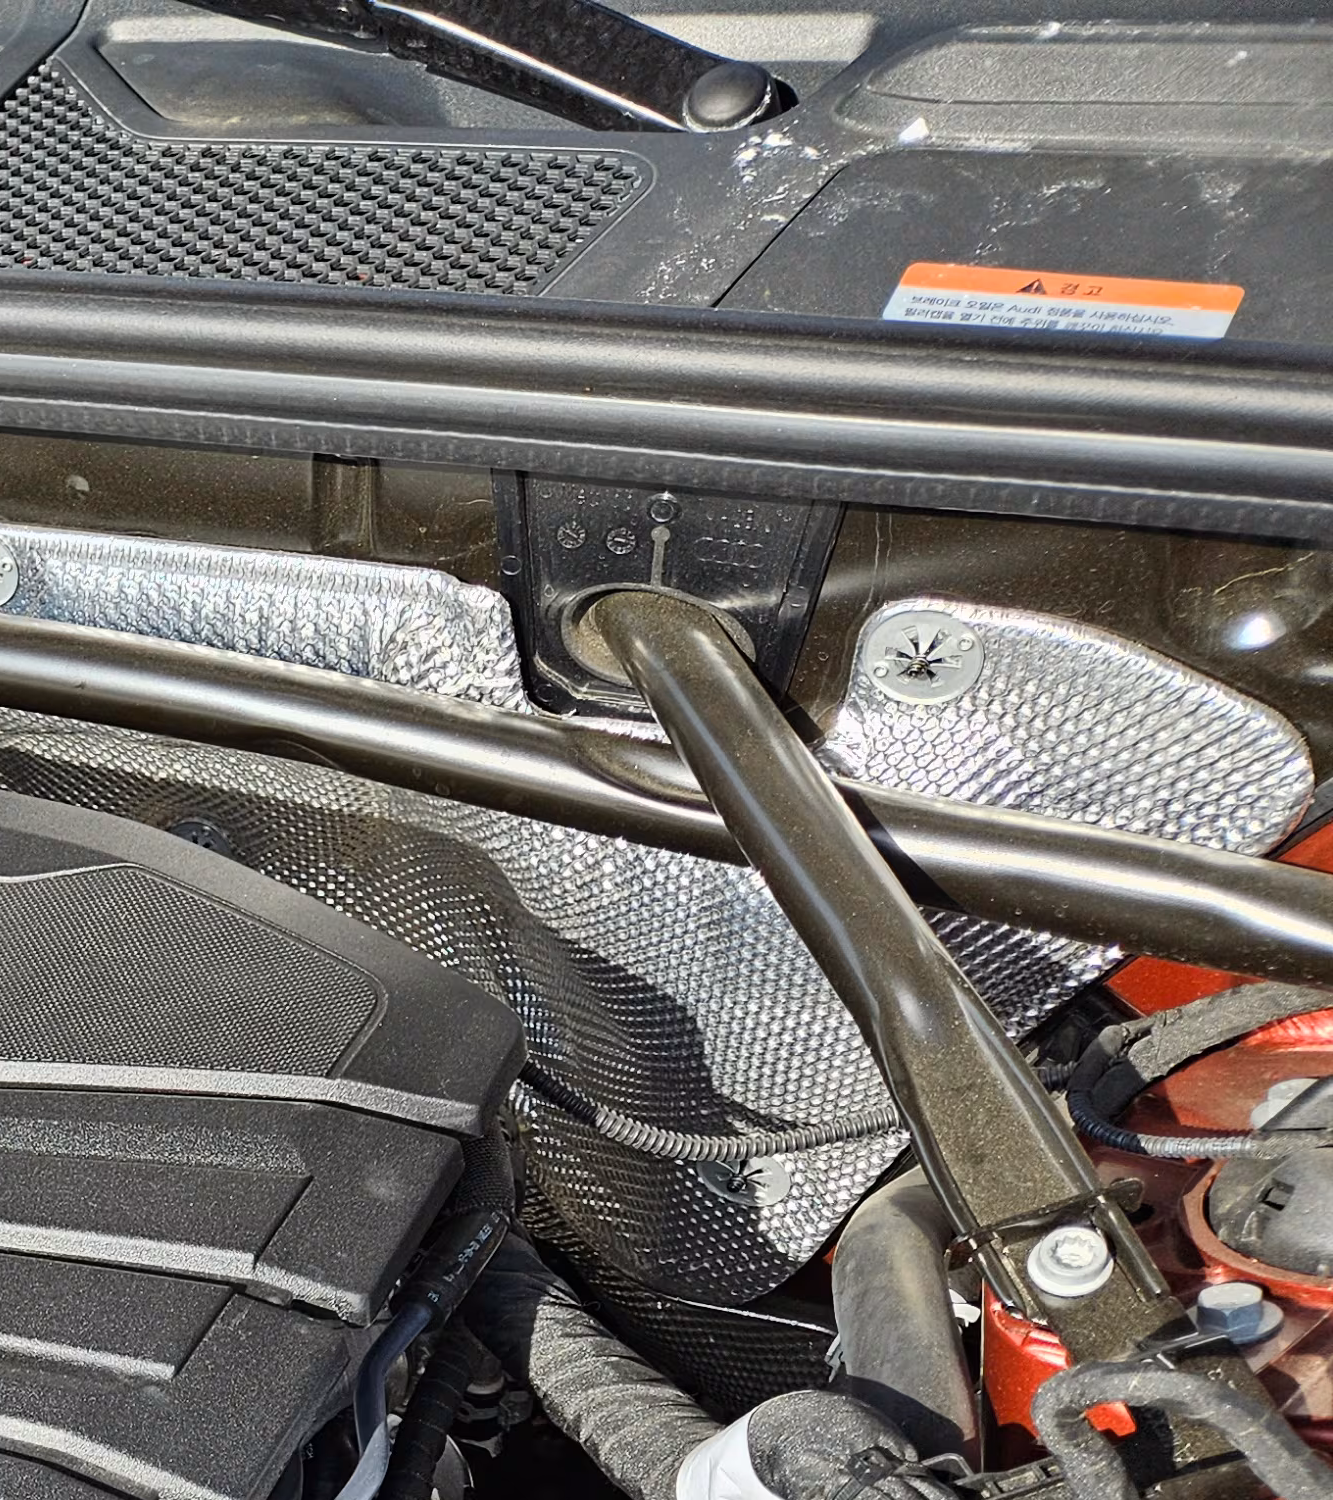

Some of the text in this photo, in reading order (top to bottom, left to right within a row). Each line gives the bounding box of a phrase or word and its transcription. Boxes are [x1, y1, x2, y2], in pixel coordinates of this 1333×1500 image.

[964, 300, 1004, 311] 오일은
[1007, 304, 1042, 314] Audi
[957, 312, 985, 322] 열기
[988, 315, 1016, 325] 전에
